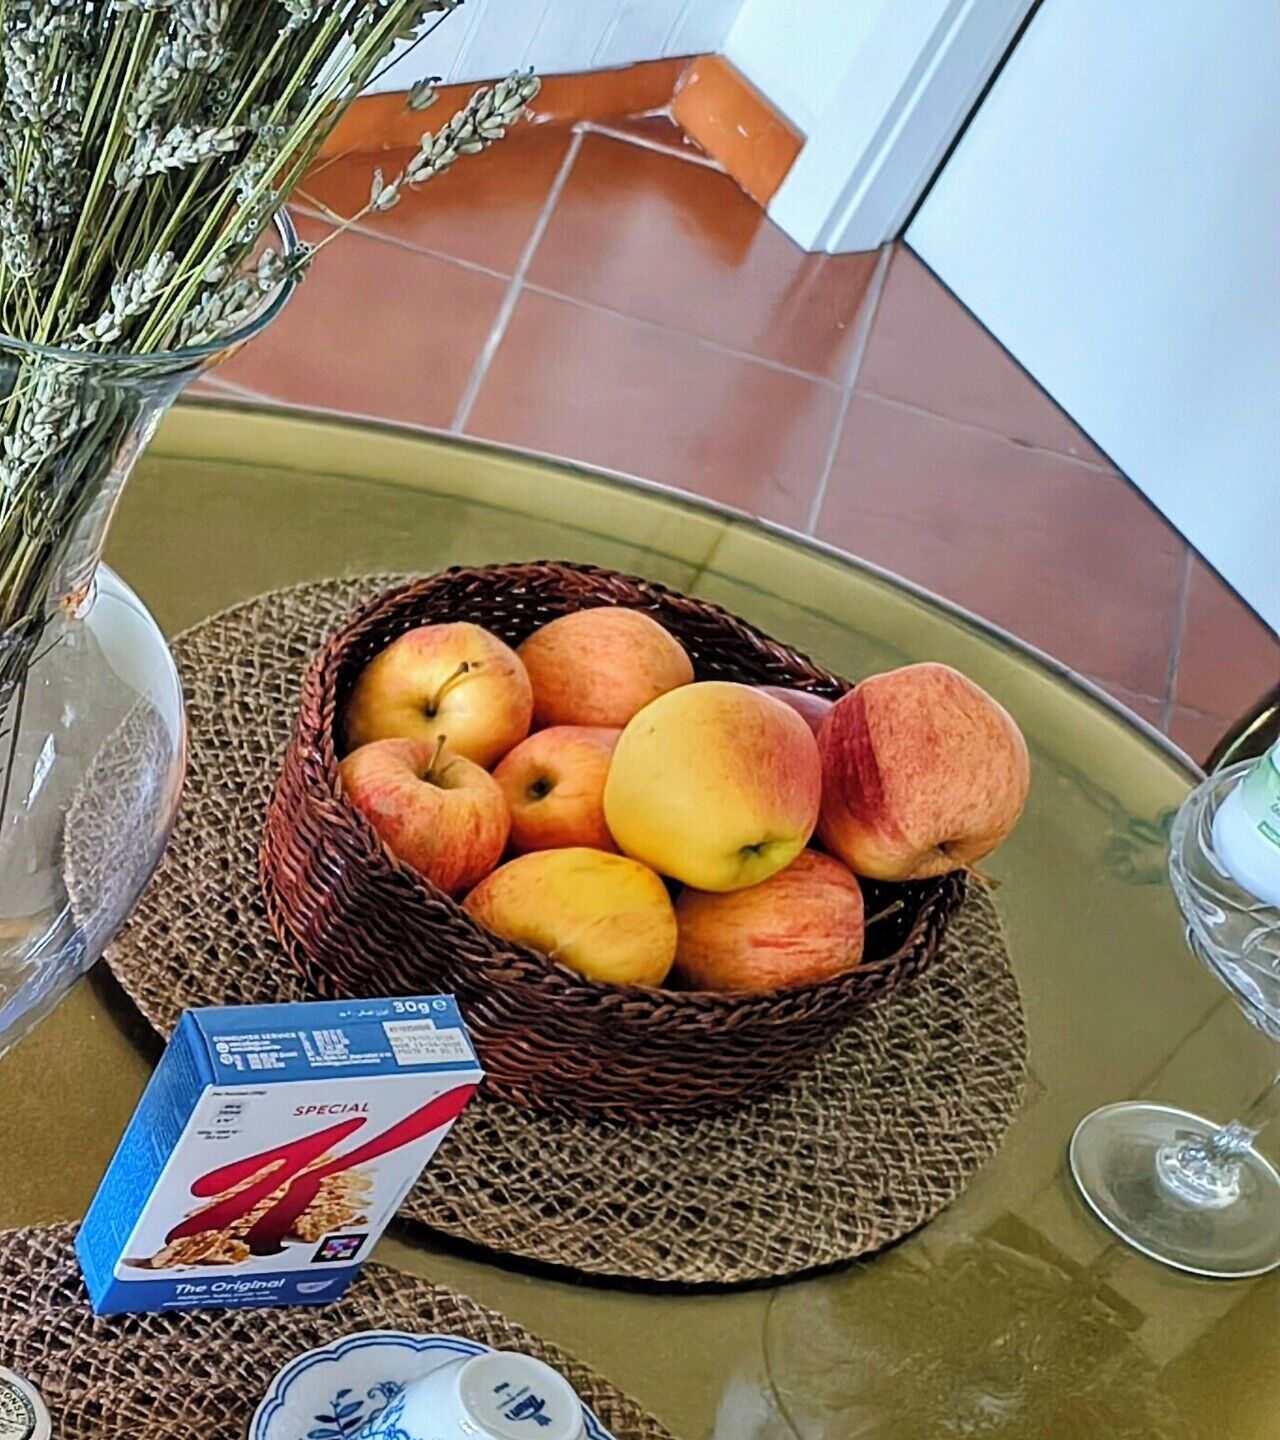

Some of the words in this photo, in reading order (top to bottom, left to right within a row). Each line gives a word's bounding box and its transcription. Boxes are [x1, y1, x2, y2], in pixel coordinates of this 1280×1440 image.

[392, 1000, 431, 1015] 30g
[293, 1102, 370, 1117] SPECIAL
[175, 1283, 207, 1295] The
[211, 1278, 286, 1293] Original
